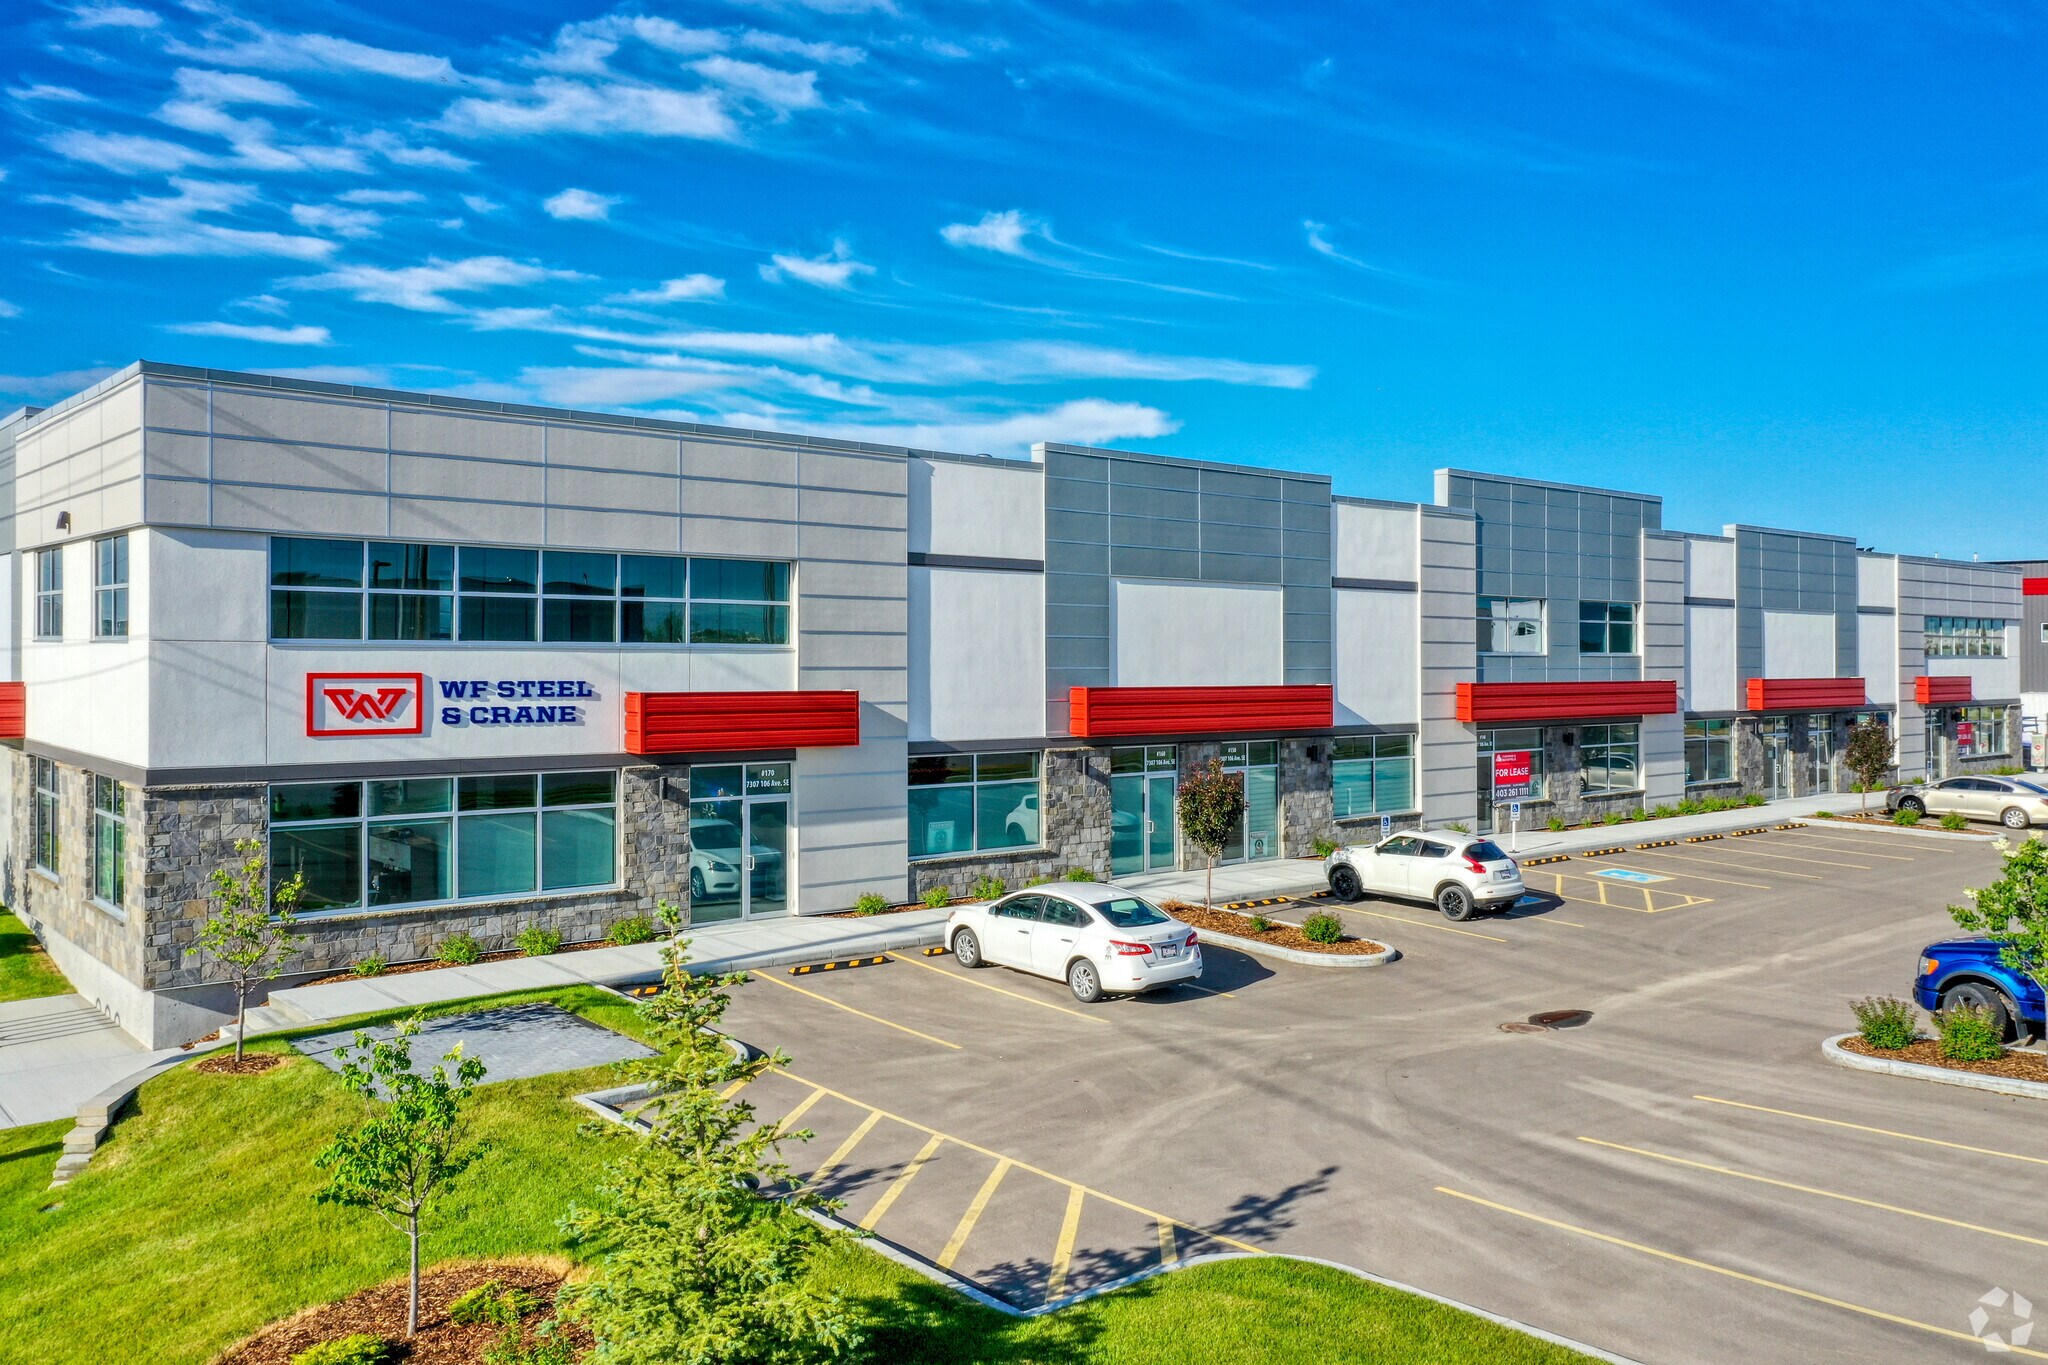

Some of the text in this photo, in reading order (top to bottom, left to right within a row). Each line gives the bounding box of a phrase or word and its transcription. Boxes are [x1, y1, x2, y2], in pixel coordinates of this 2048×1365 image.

[439, 680, 593, 698] WF STEEL
[441, 705, 577, 725] & CRANE
[761, 769, 775, 777] #170
[1495, 767, 1529, 777] FOR LEASE
[746, 780, 759, 788] 7307
[760, 779, 770, 787] 106
[771, 779, 783, 787] Ave.
[1495, 787, 1529, 797] 403 261 1111
